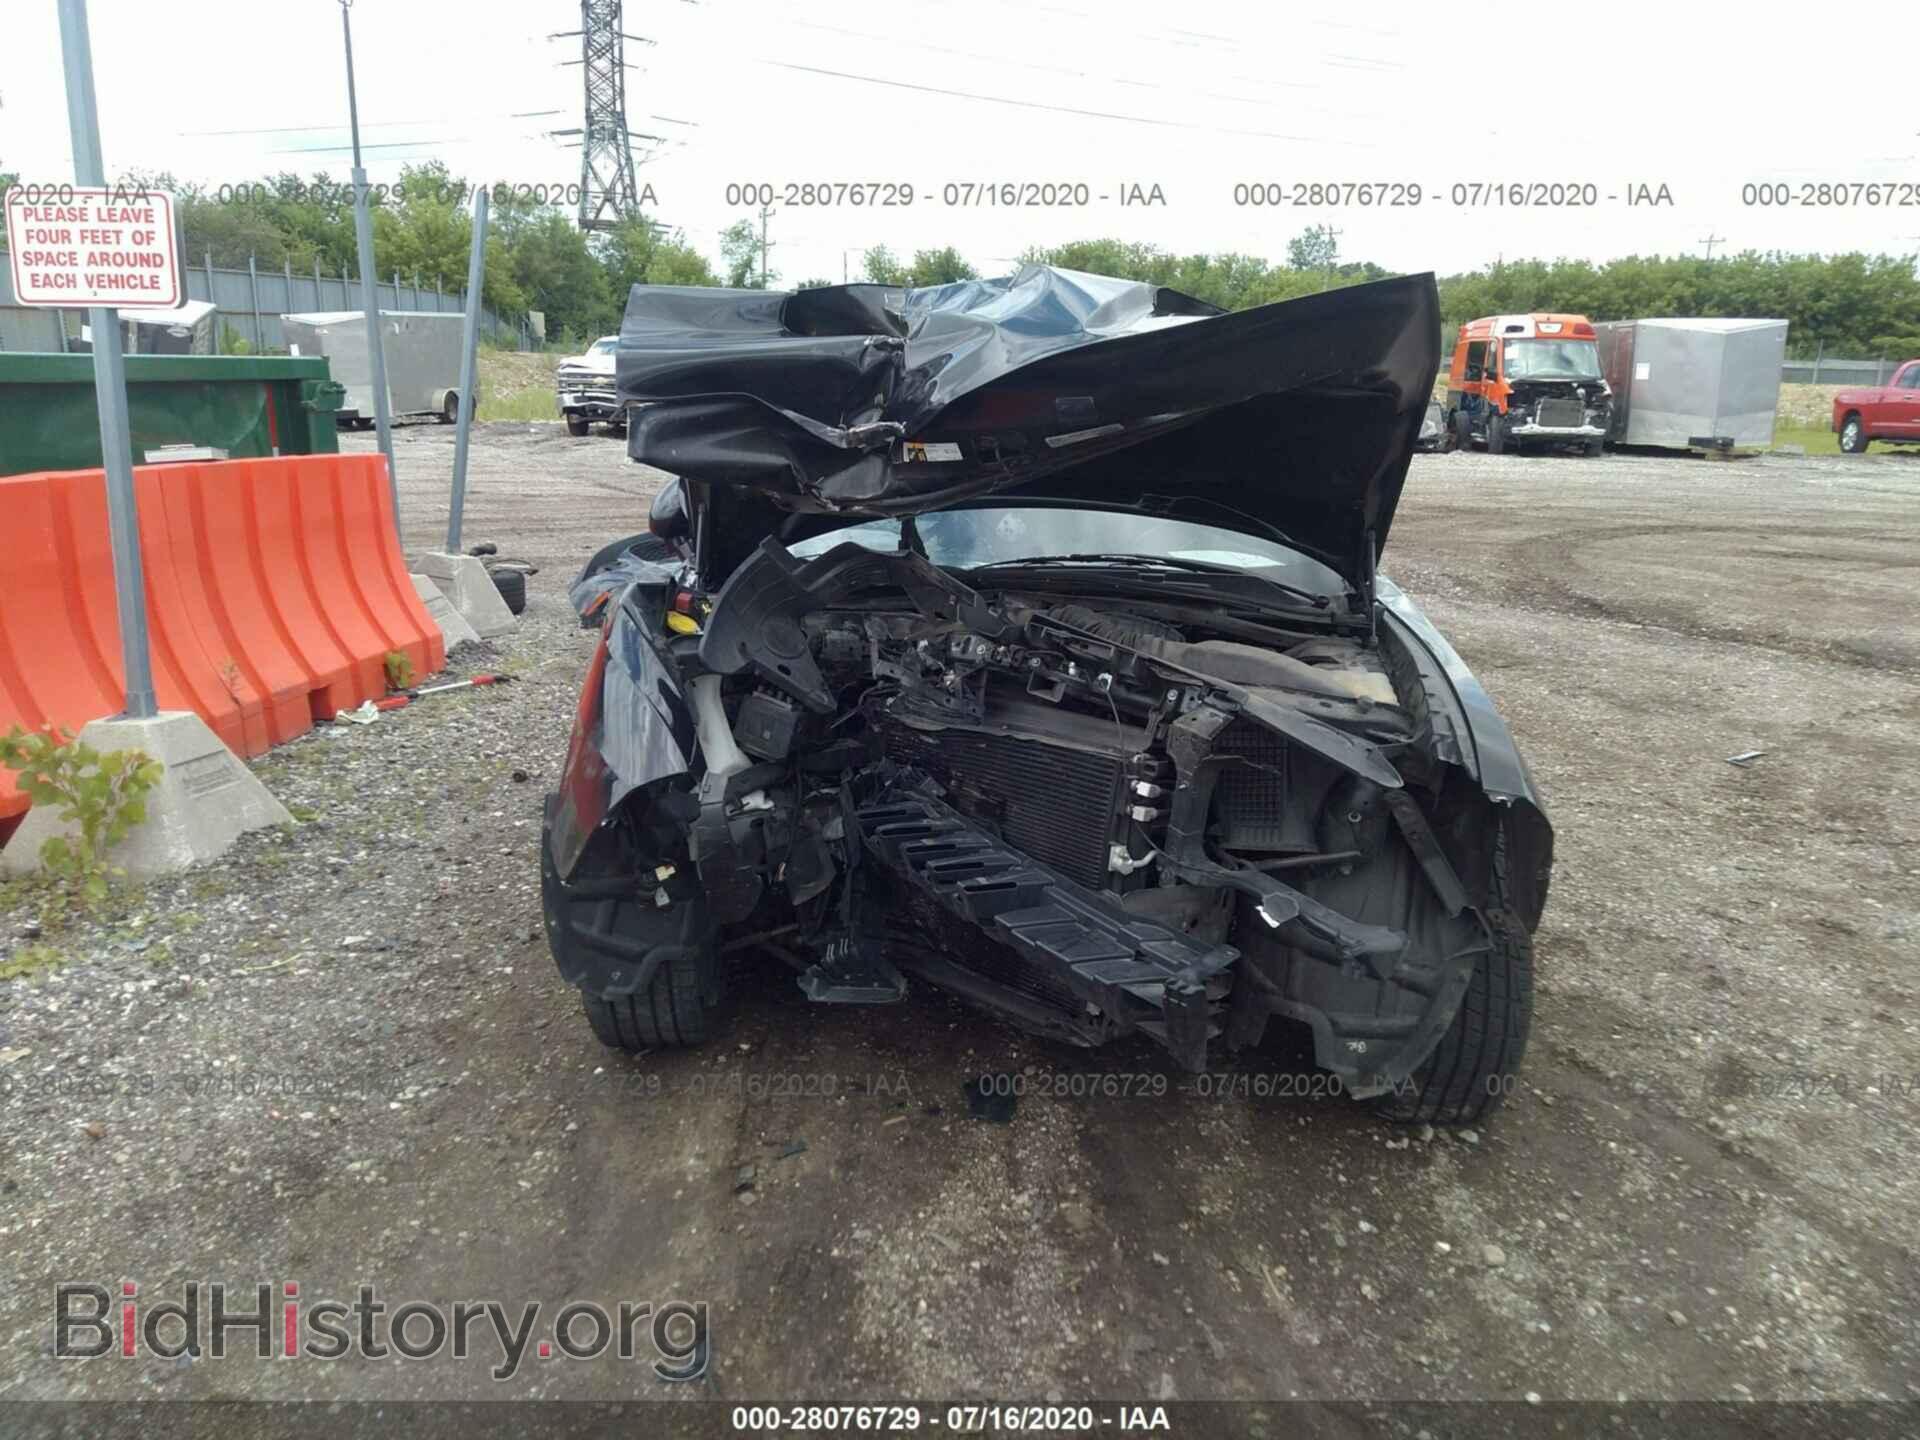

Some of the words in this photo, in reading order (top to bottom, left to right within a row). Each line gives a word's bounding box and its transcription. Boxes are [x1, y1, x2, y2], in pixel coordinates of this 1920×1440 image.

[23, 207, 89, 222] PLEASE
[97, 208, 155, 224] LEAVE
[25, 229, 72, 245] FOUR
[79, 229, 123, 245] FEET
[131, 230, 156, 246] OF
[22, 251, 78, 267] SPACE
[87, 252, 164, 268] AROUND
[31, 273, 77, 289] EACH
[84, 274, 161, 290] VEHICLE
